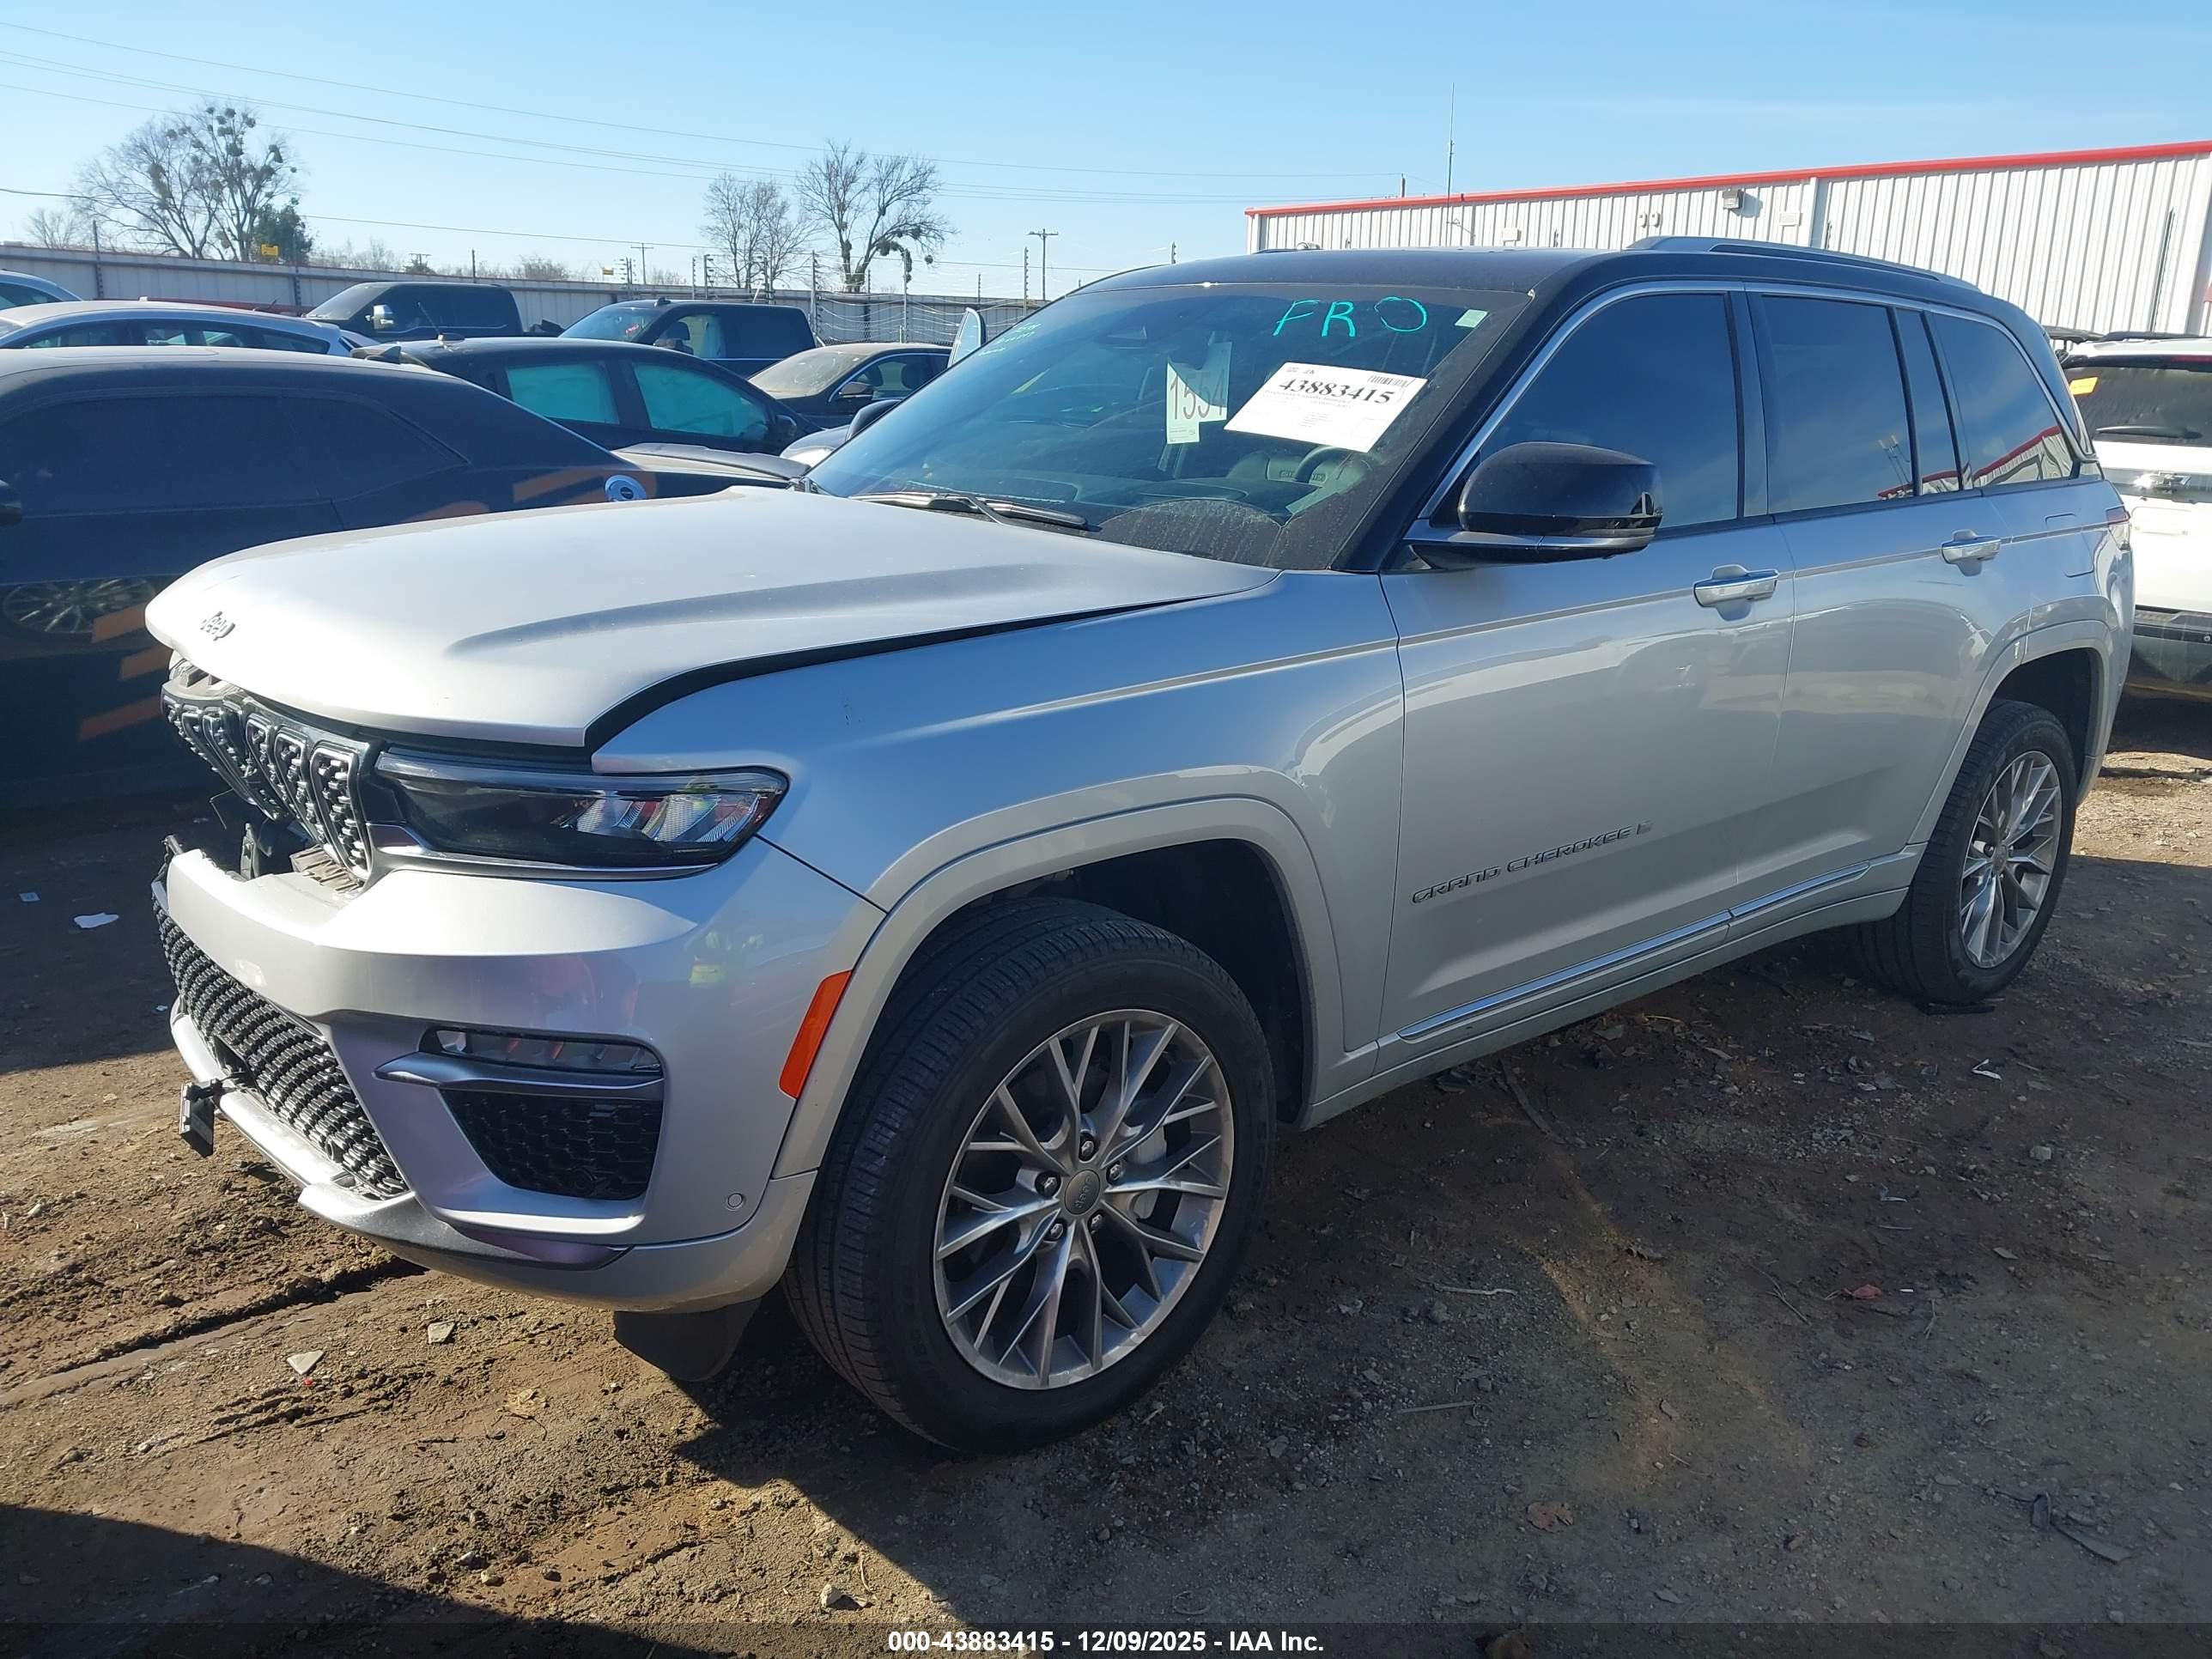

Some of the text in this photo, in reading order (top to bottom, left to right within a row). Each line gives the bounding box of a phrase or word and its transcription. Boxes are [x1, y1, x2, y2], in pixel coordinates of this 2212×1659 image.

[1279, 378, 1396, 404] 43883415
[1412, 866, 1501, 903] GRAND
[1507, 825, 1633, 872] CHEROKEE
